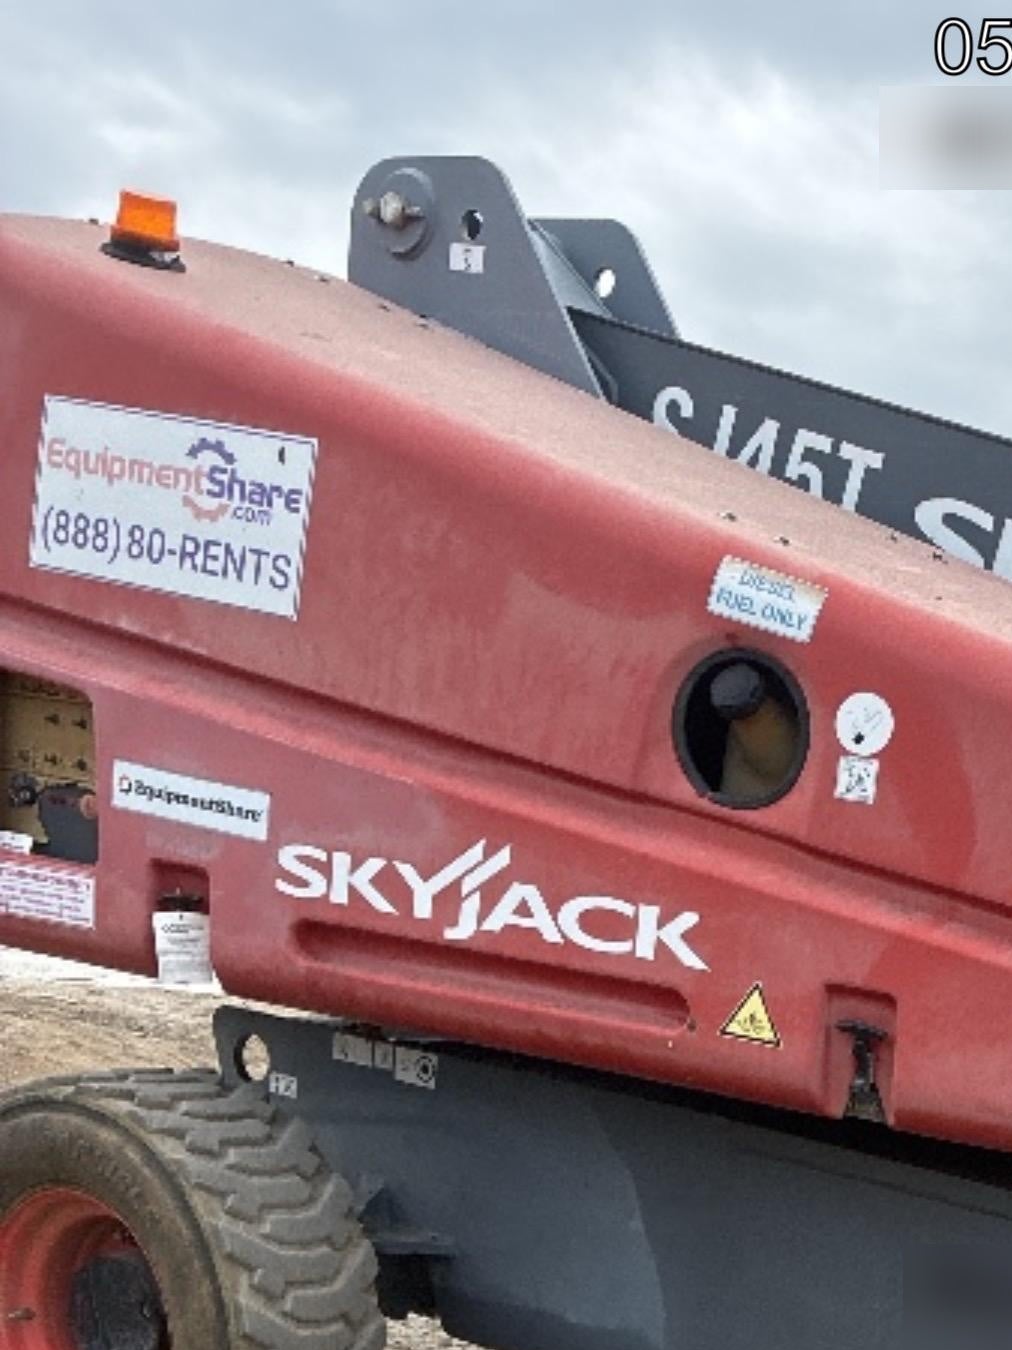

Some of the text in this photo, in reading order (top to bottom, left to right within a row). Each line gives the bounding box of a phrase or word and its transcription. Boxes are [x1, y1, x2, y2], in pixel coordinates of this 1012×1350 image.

[46, 437, 303, 513] EquipmentShare
[716, 588, 807, 631] FUEL ONLY
[275, 838, 710, 972] SKYJACK
